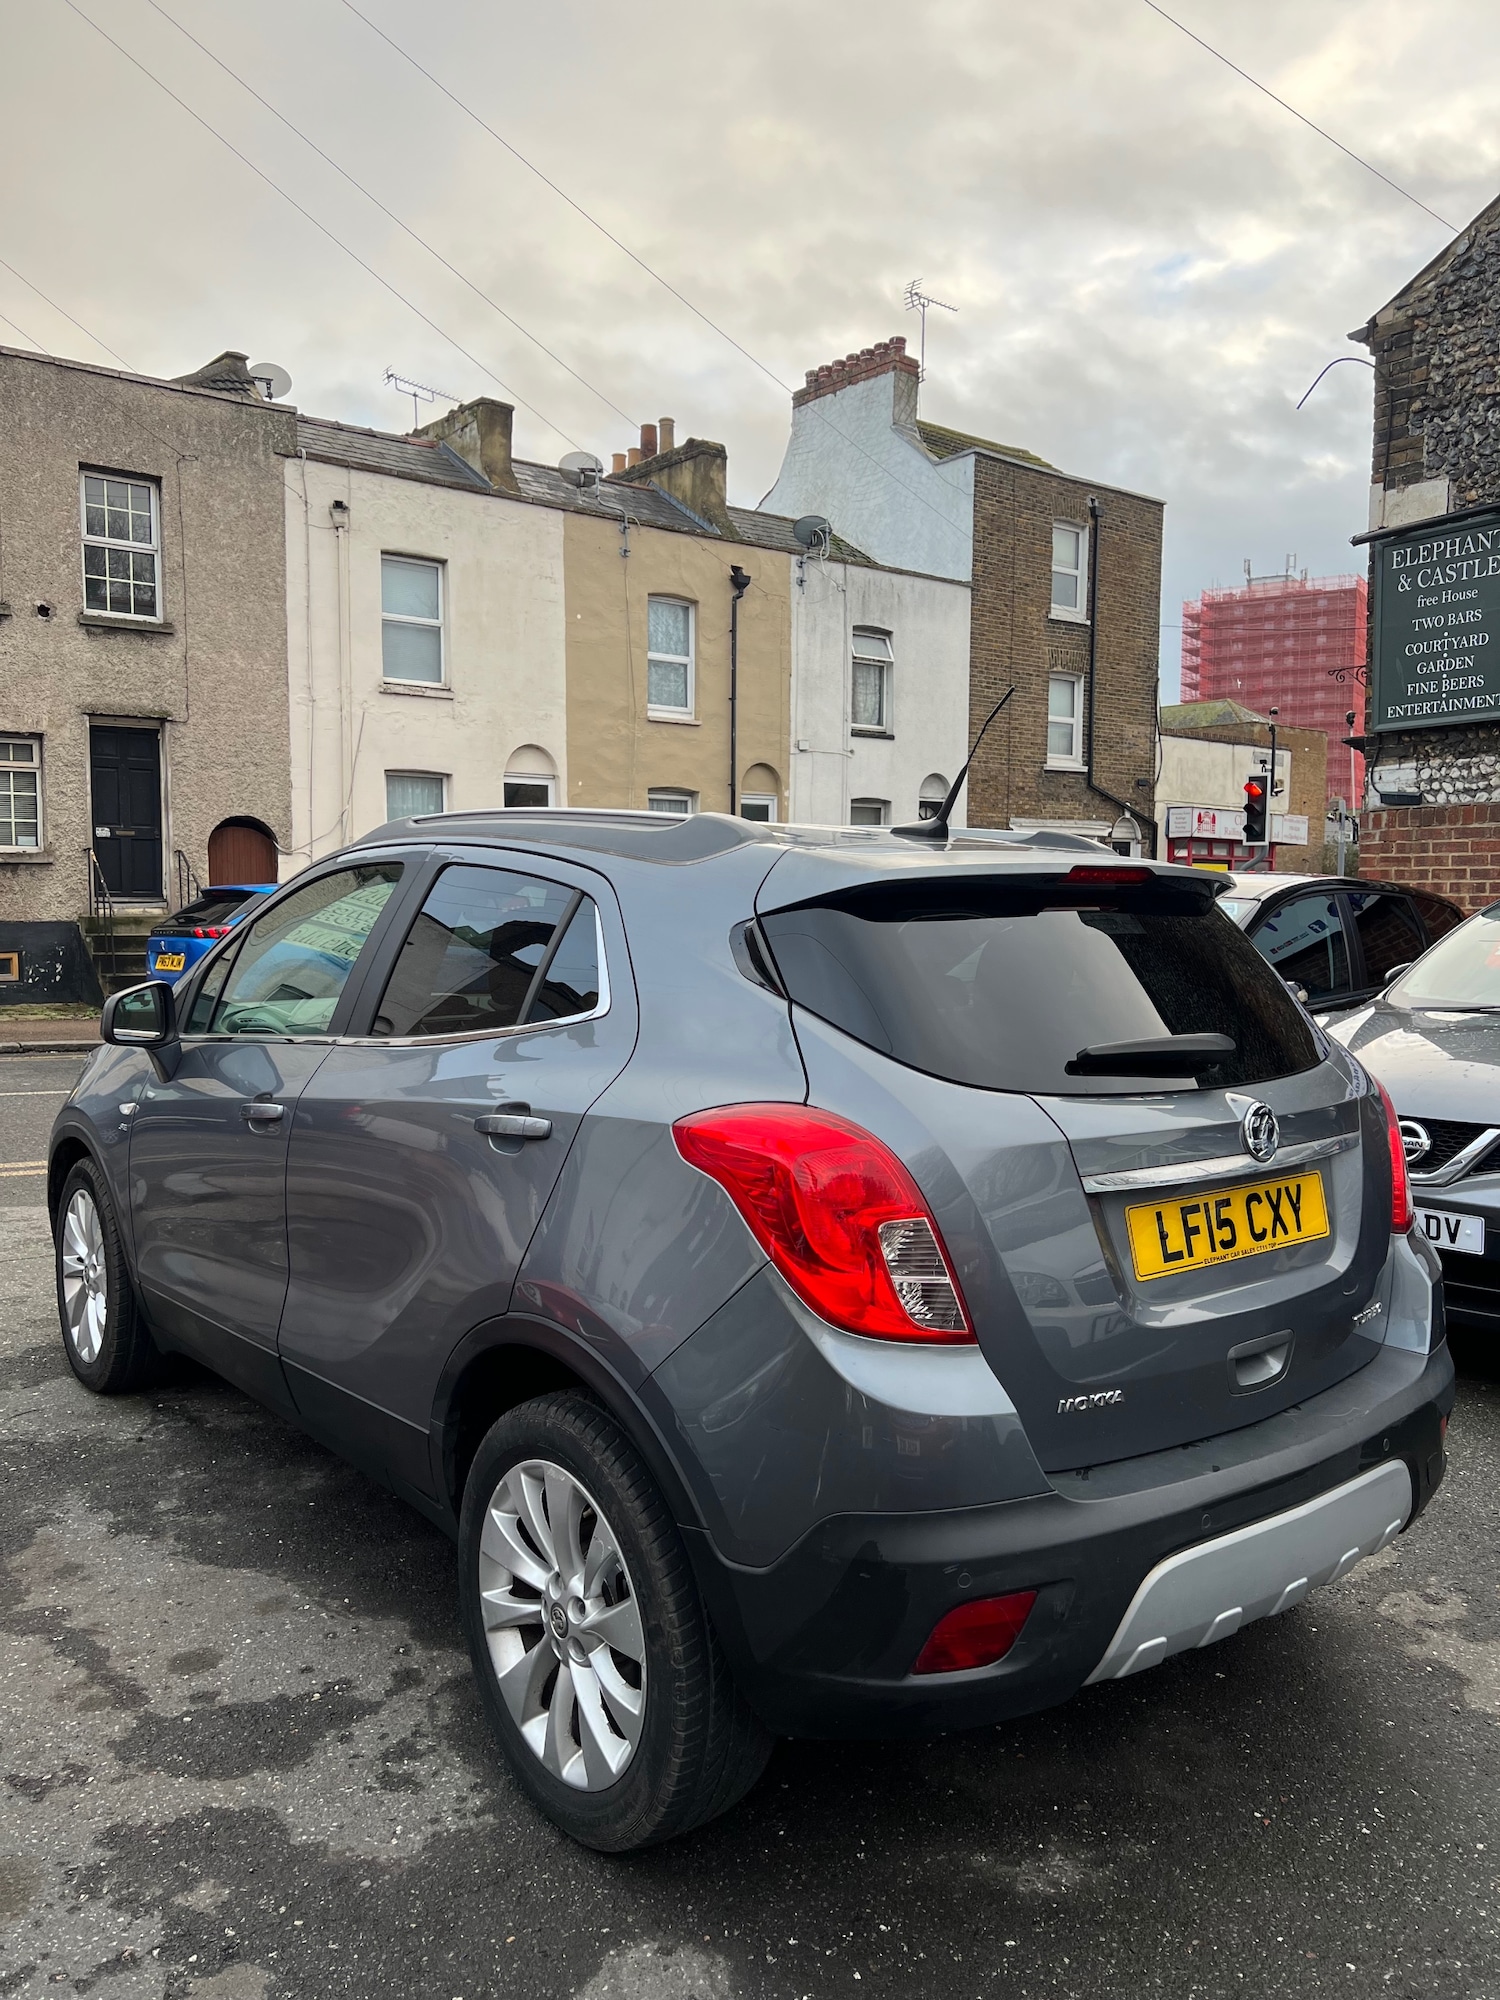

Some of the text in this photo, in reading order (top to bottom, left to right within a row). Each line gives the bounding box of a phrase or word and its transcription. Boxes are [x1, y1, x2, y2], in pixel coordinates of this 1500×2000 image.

[1397, 555, 1500, 593] & CASTLE
[1417, 588, 1478, 608] free House
[1412, 608, 1482, 631] TWO BARS
[1404, 632, 1489, 656] COURTYARD
[1416, 655, 1475, 675] GARDEN
[1407, 674, 1484, 695] FINE BEERS
[1155, 1183, 1303, 1264] LF15 CXY
[1424, 1214, 1461, 1244] DV
[1203, 1253, 1229, 1264] ELEPHANT
[1241, 1247, 1256, 1256] SALES
[1057, 1389, 1125, 1414] MOKKA
